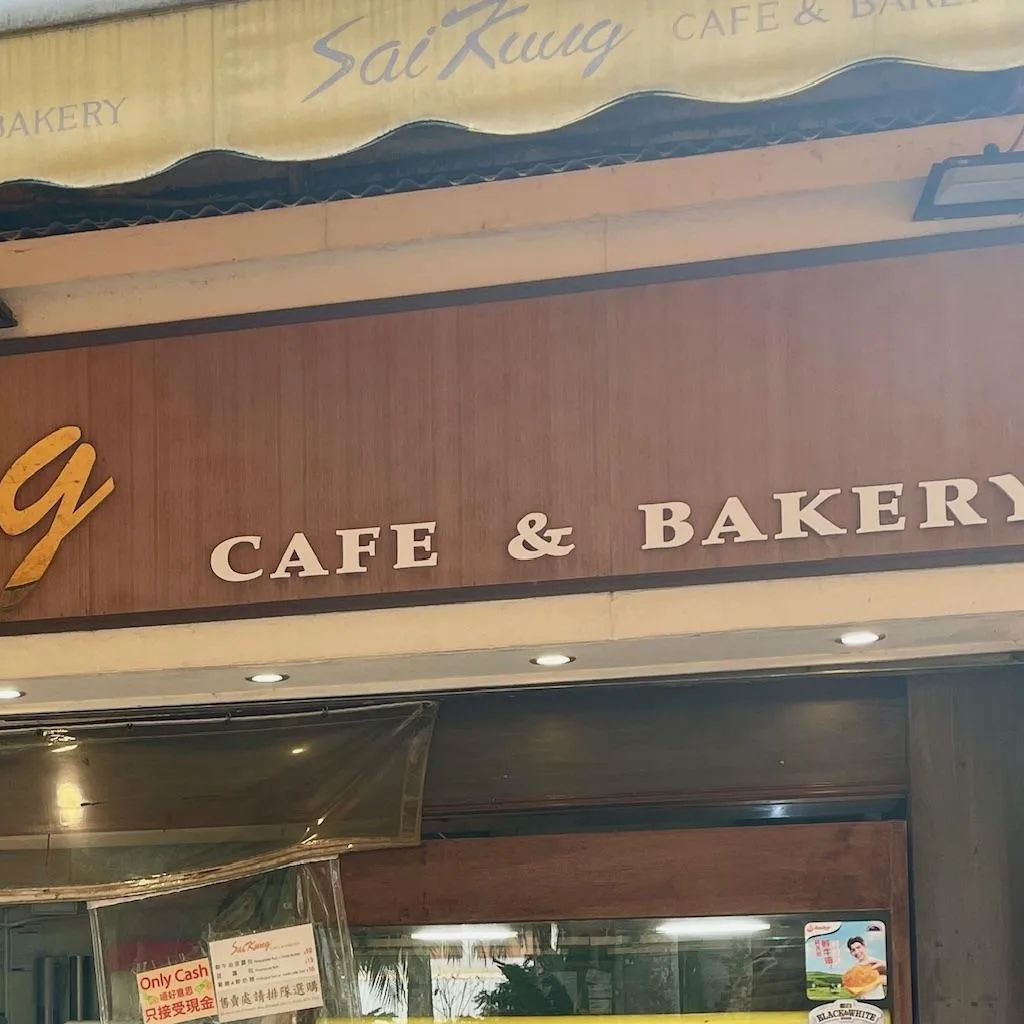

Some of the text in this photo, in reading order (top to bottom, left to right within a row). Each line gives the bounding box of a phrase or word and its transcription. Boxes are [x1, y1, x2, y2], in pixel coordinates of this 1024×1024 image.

[300, 15, 437, 103] Sai
[673, 1, 780, 41] CAFE
[793, 0, 830, 27] &
[209, 521, 440, 583] CAFE
[507, 511, 576, 561] &
[140, 973, 172, 990] Only
[175, 964, 209, 983] Cash
[145, 995, 215, 1022] 只接受現金
